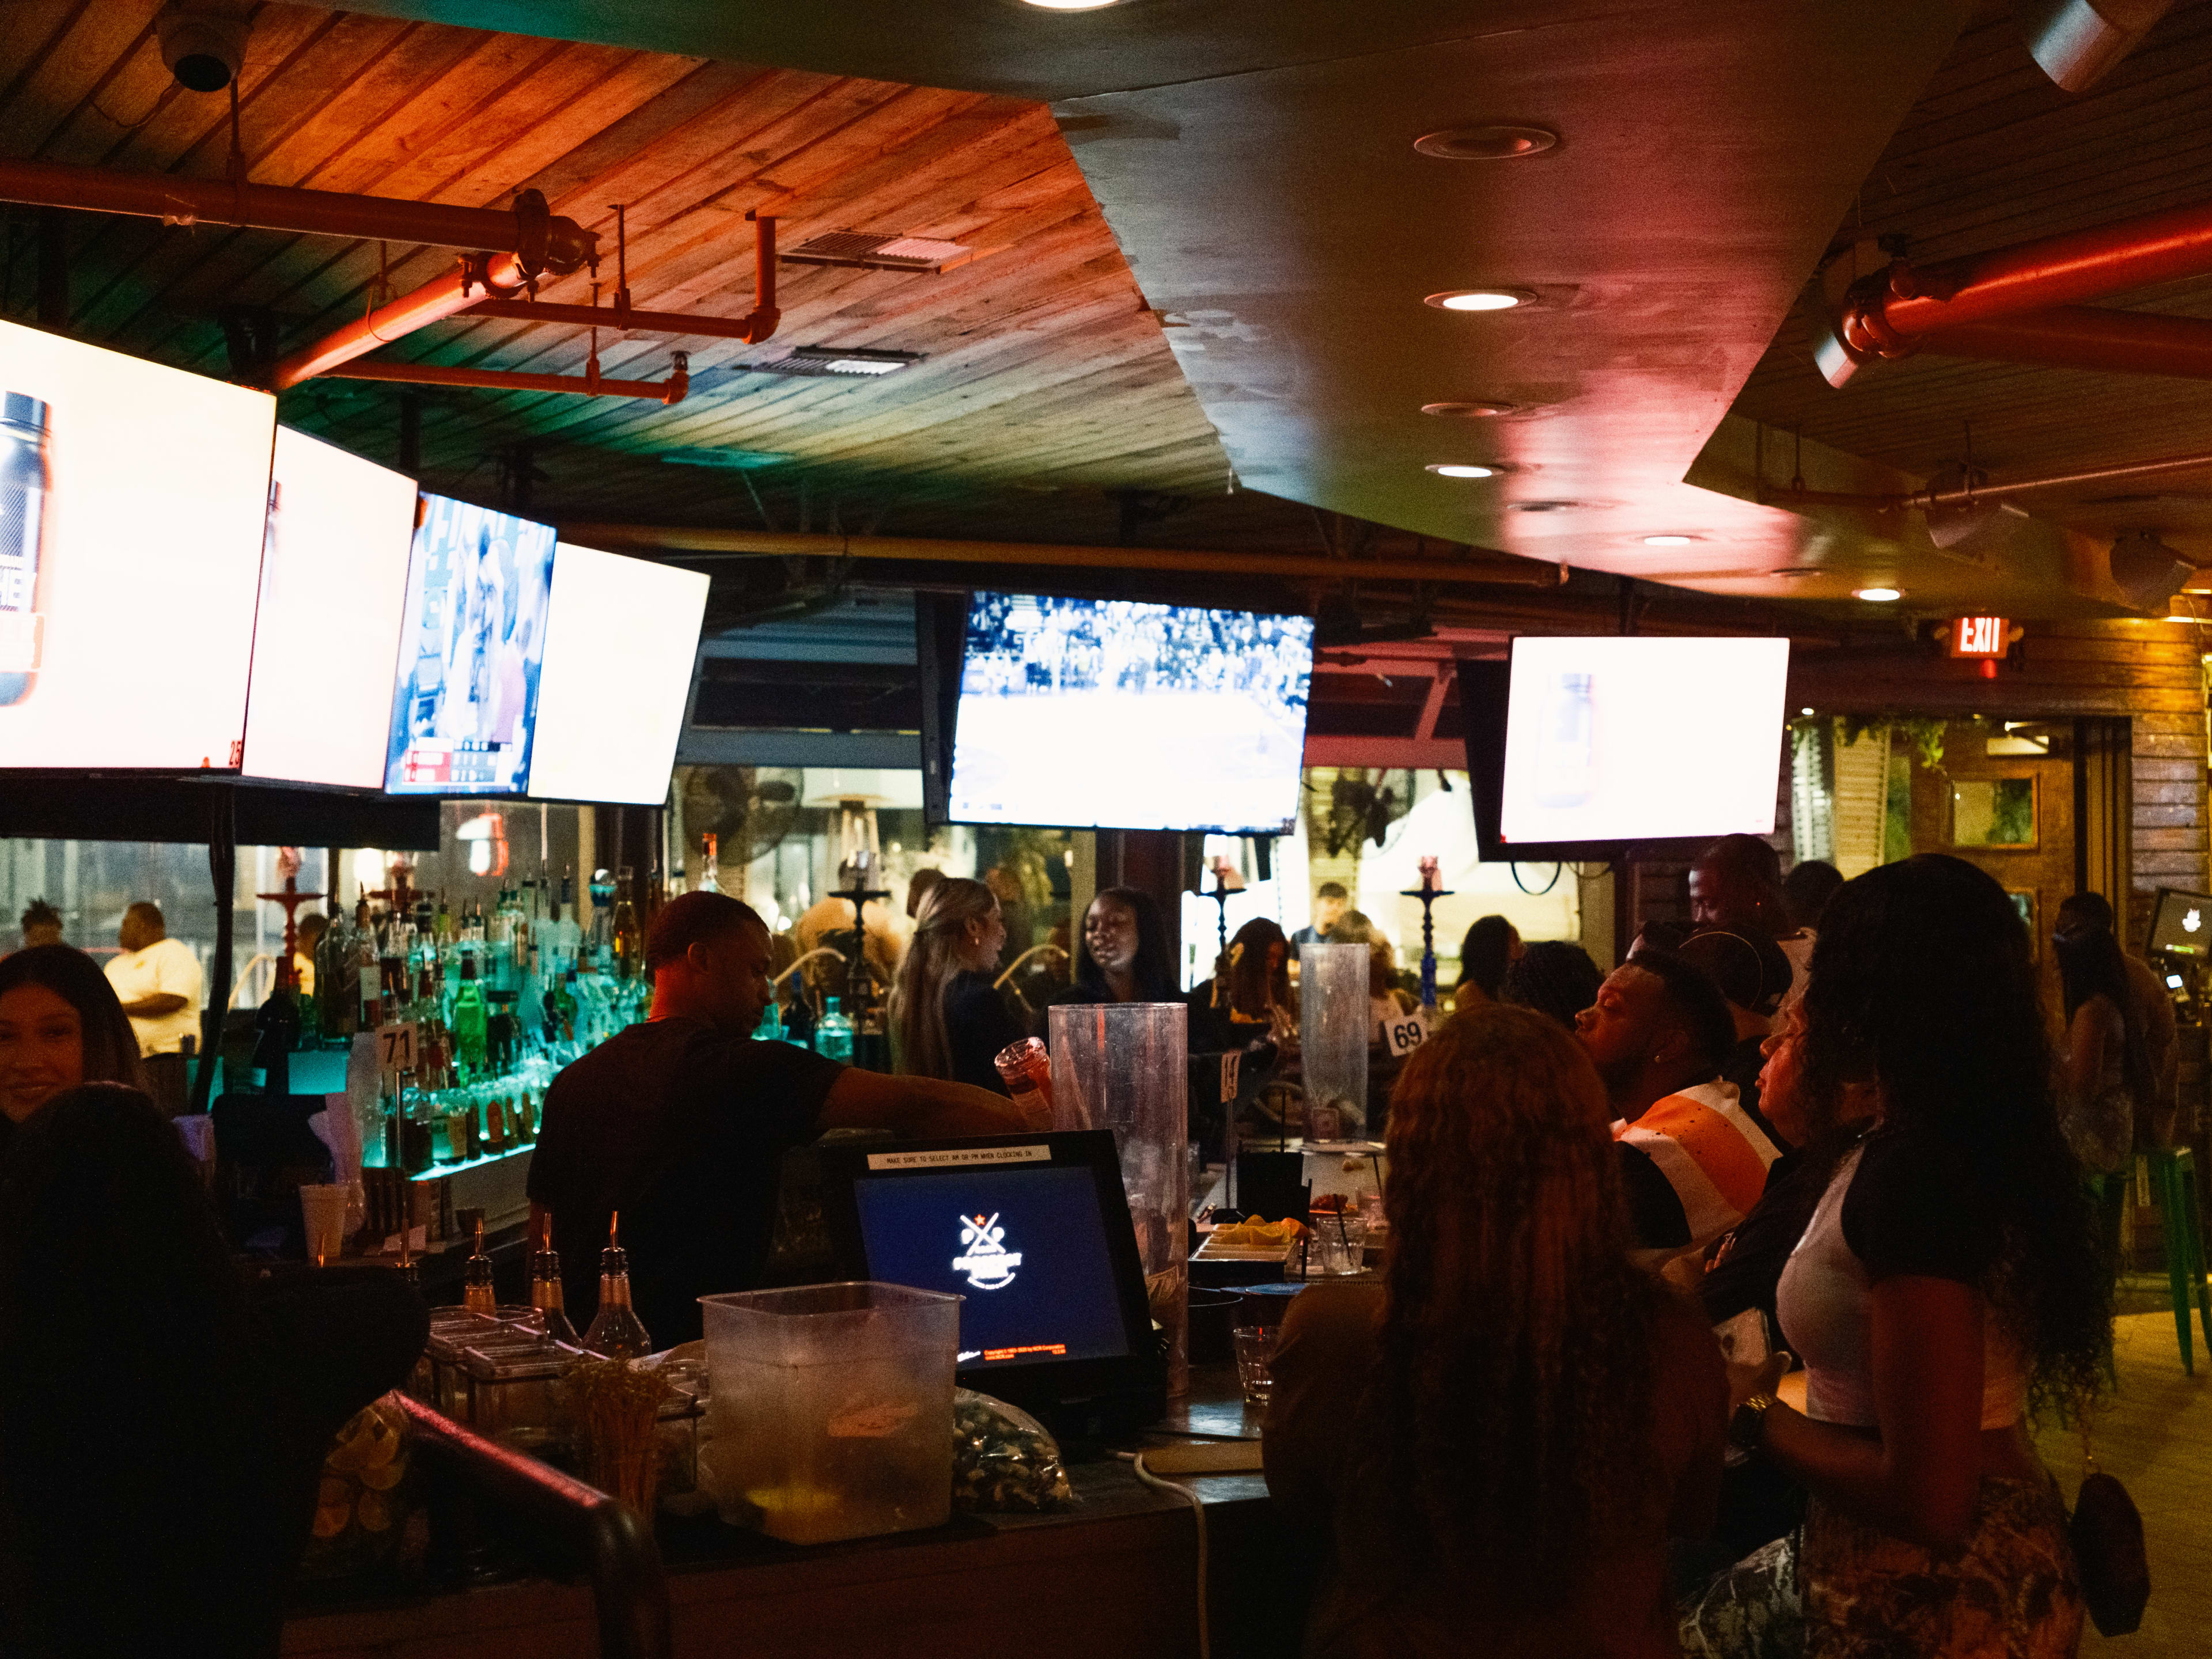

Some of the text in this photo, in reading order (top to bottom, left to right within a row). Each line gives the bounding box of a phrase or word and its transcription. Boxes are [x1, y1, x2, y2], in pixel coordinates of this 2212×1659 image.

[1960, 618, 2000, 652] EXIT
[229, 740, 241, 766] 25
[383, 1029, 410, 1063] 71
[1395, 1021, 1422, 1048] 69
